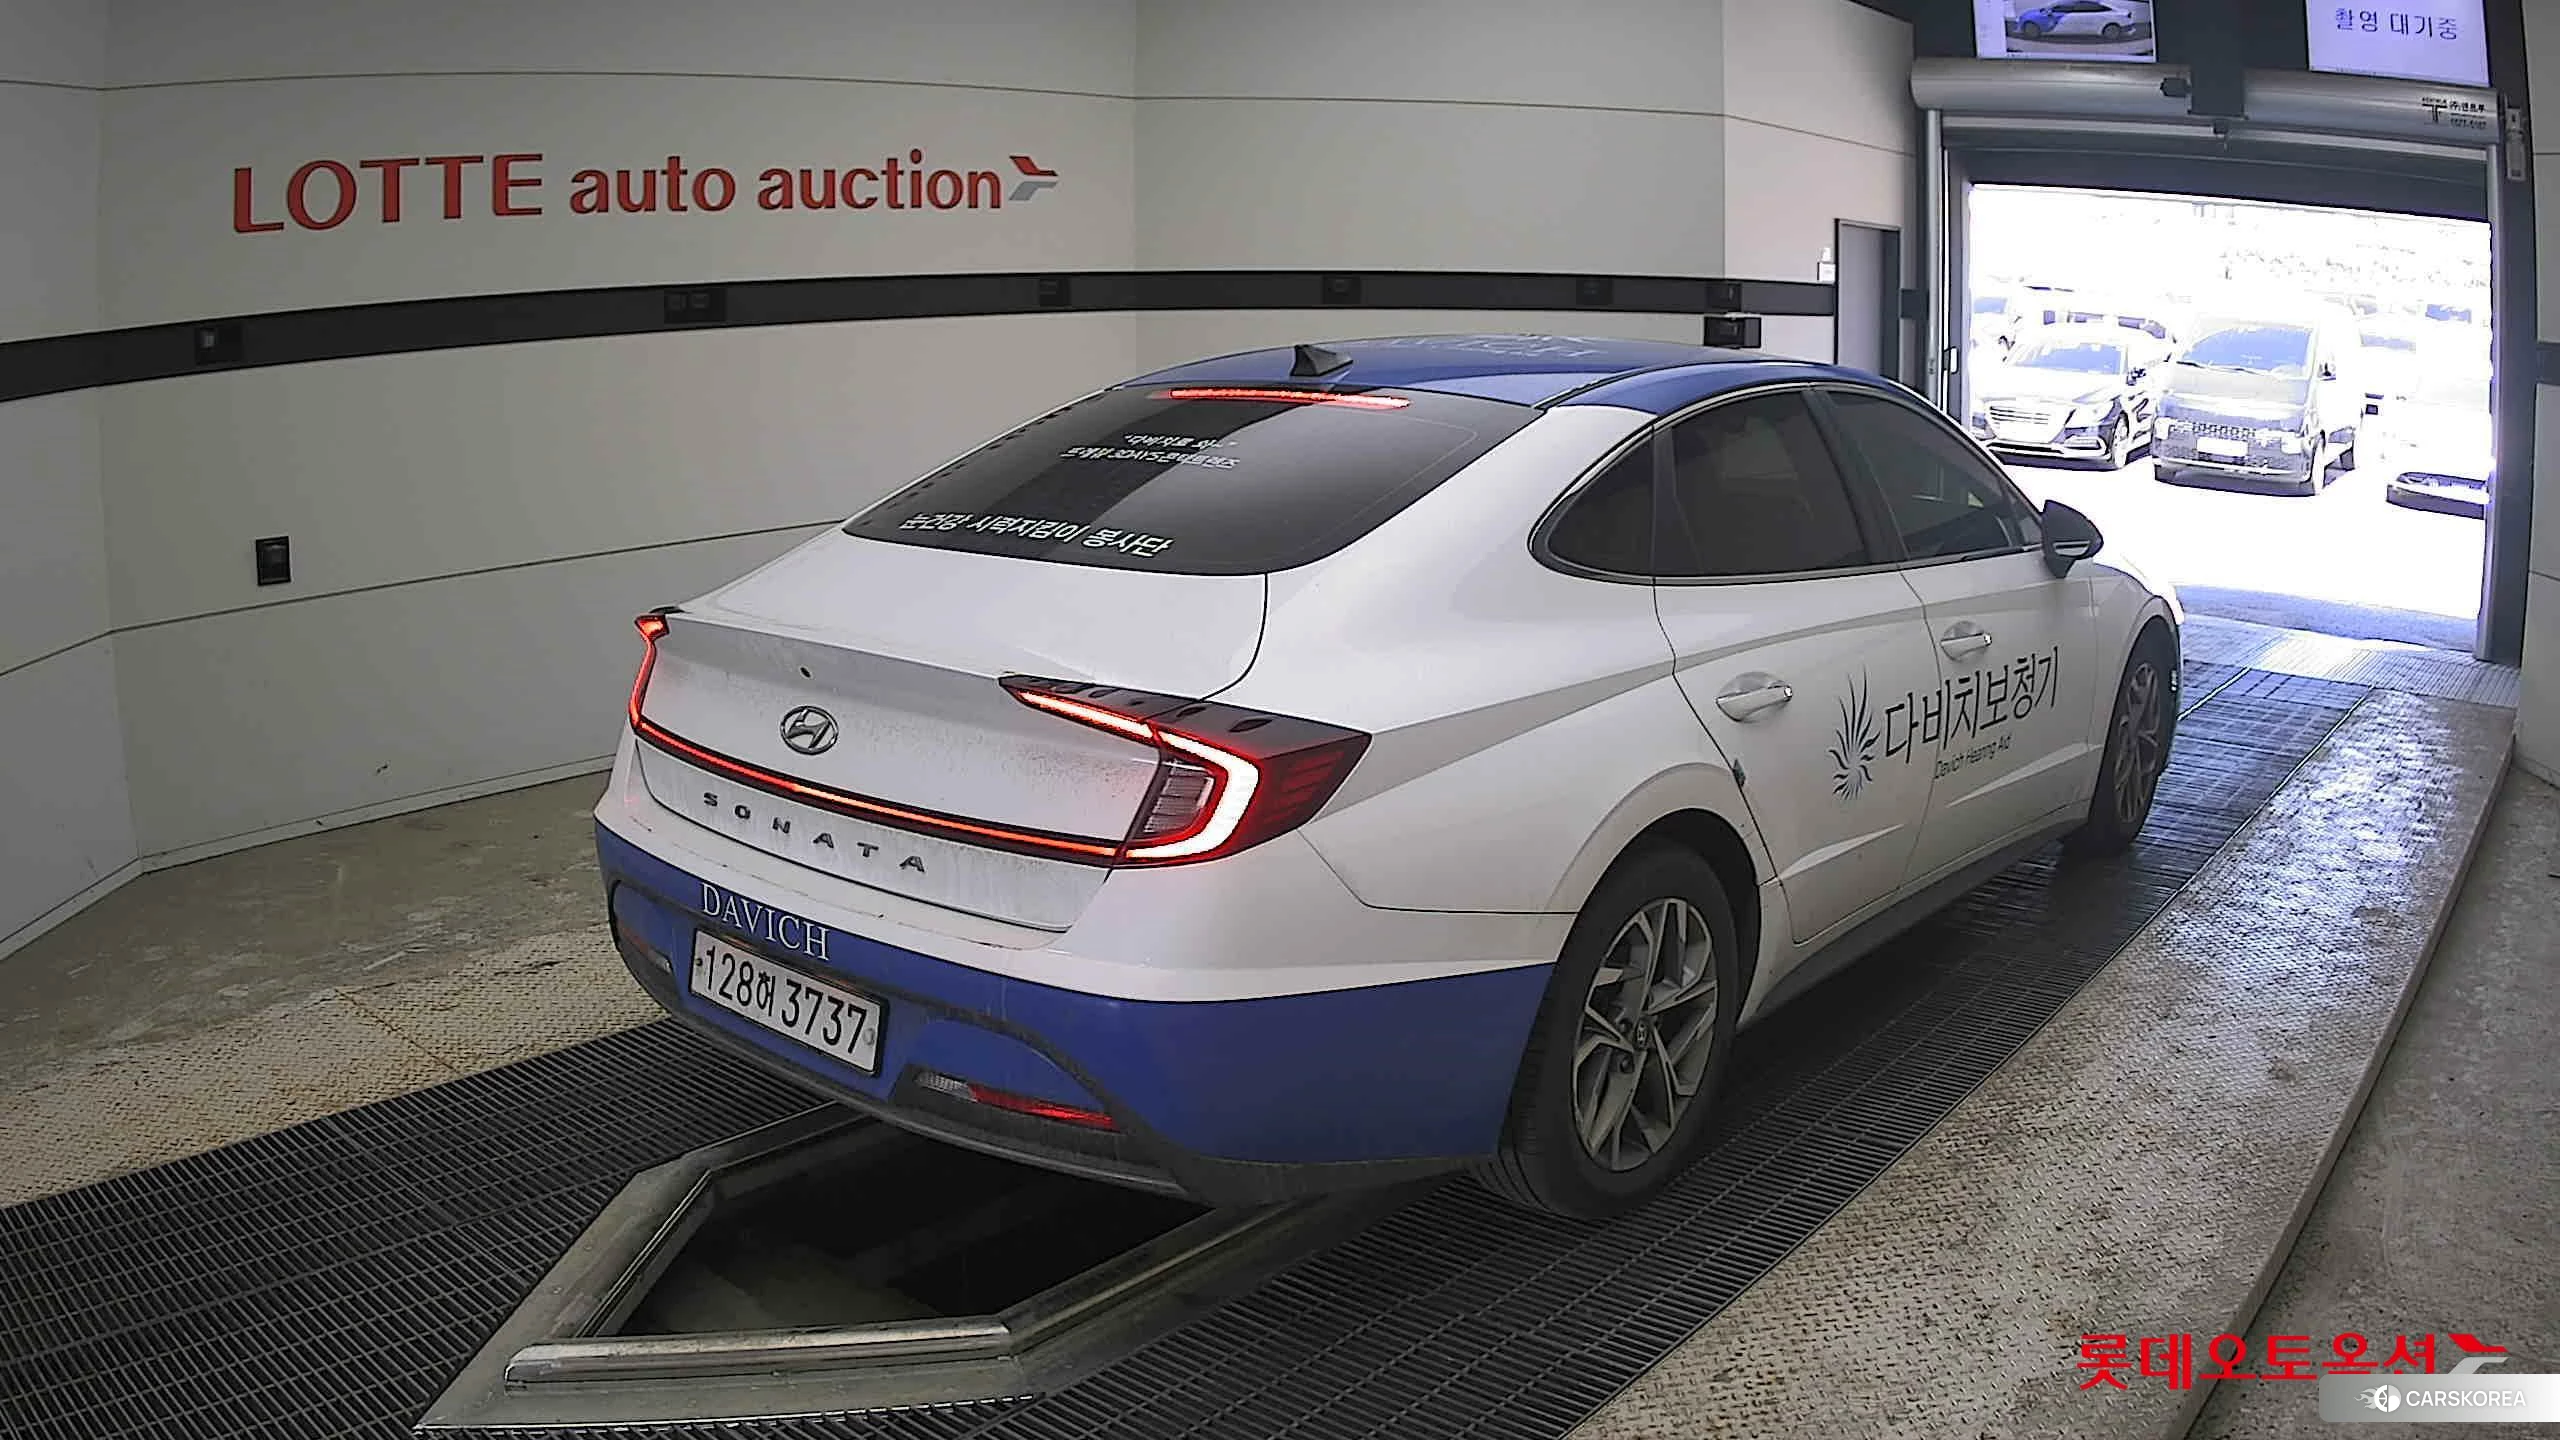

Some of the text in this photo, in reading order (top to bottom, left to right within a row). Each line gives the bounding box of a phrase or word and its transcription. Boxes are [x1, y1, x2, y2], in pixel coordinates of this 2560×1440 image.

[2335, 7, 2458, 41] 촬영 대기중
[233, 148, 1002, 233] LOTTE auto auction
[898, 512, 1176, 558] 눈건강 시력지킴이 봉사단
[1883, 645, 2059, 765] 다비치보청기
[702, 791, 928, 874] SONATA
[701, 882, 830, 961] DAVICH
